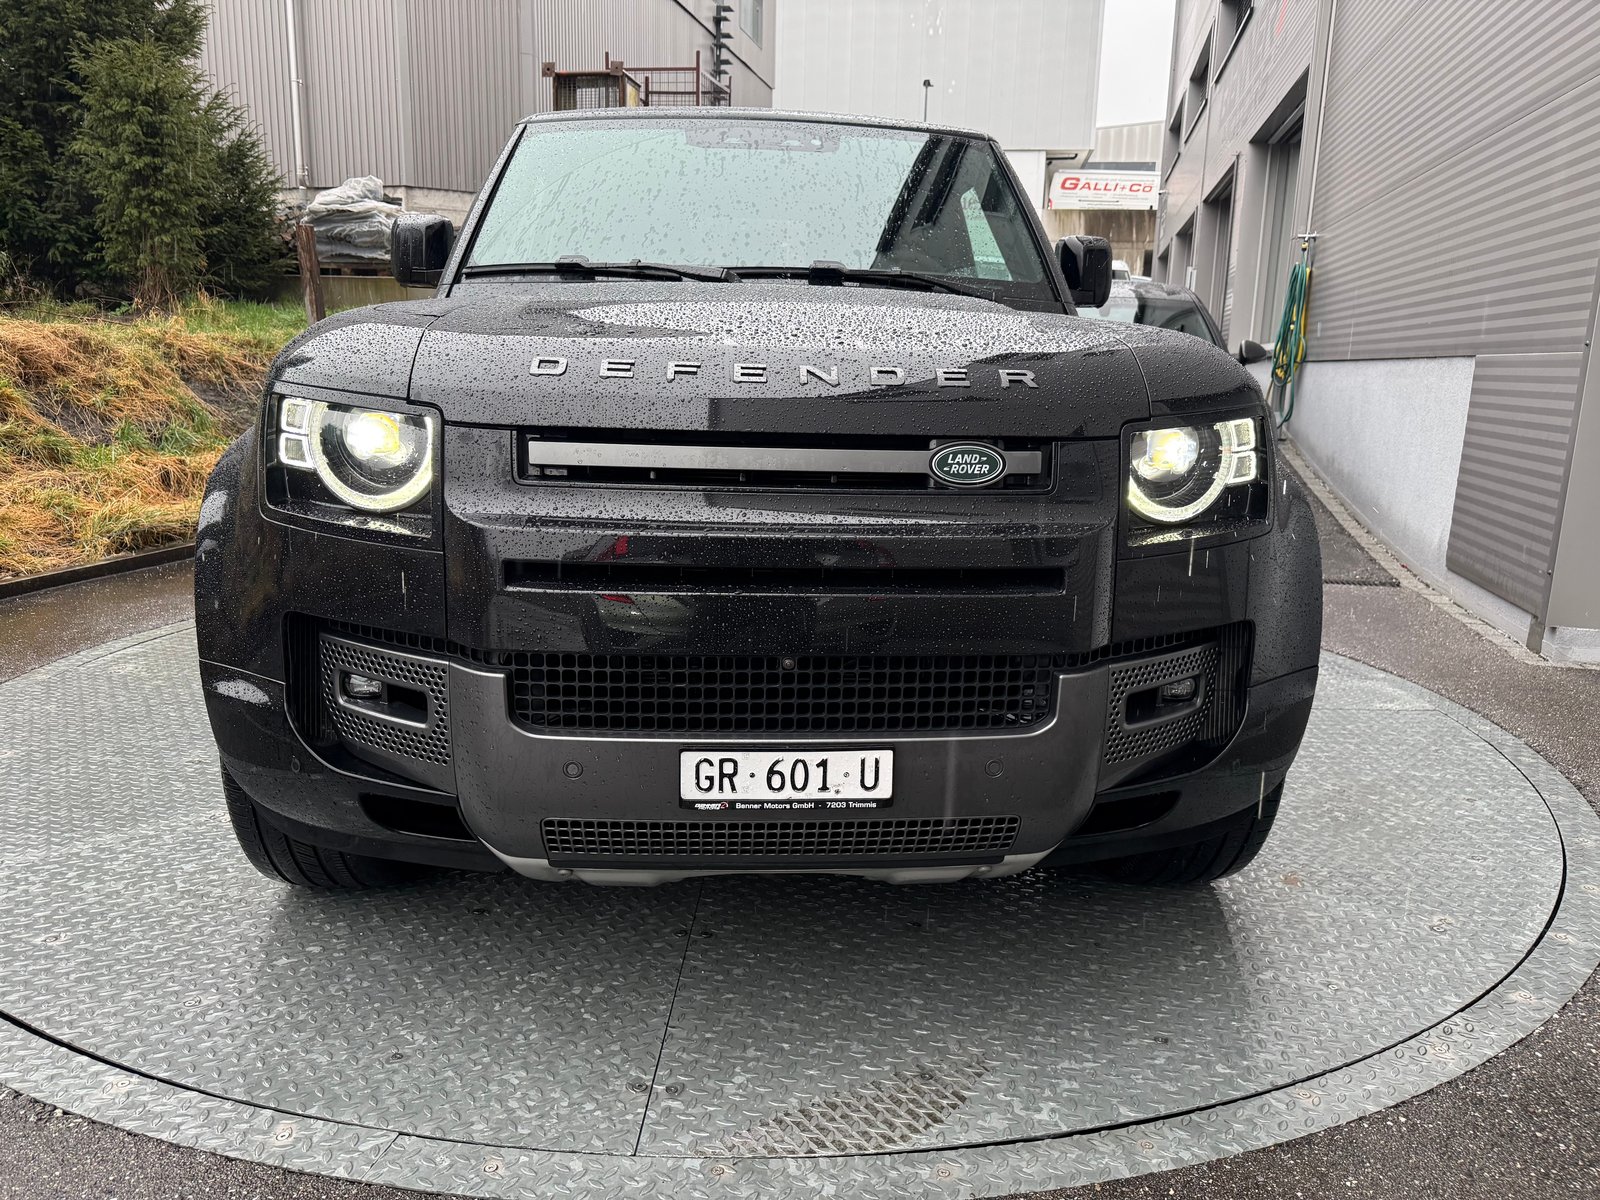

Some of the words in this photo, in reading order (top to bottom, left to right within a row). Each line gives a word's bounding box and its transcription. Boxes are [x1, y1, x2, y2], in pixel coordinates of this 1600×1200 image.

[529, 356, 1040, 389] DEFENDER
[860, 756, 880, 792] U
[826, 801, 847, 809] 7203
